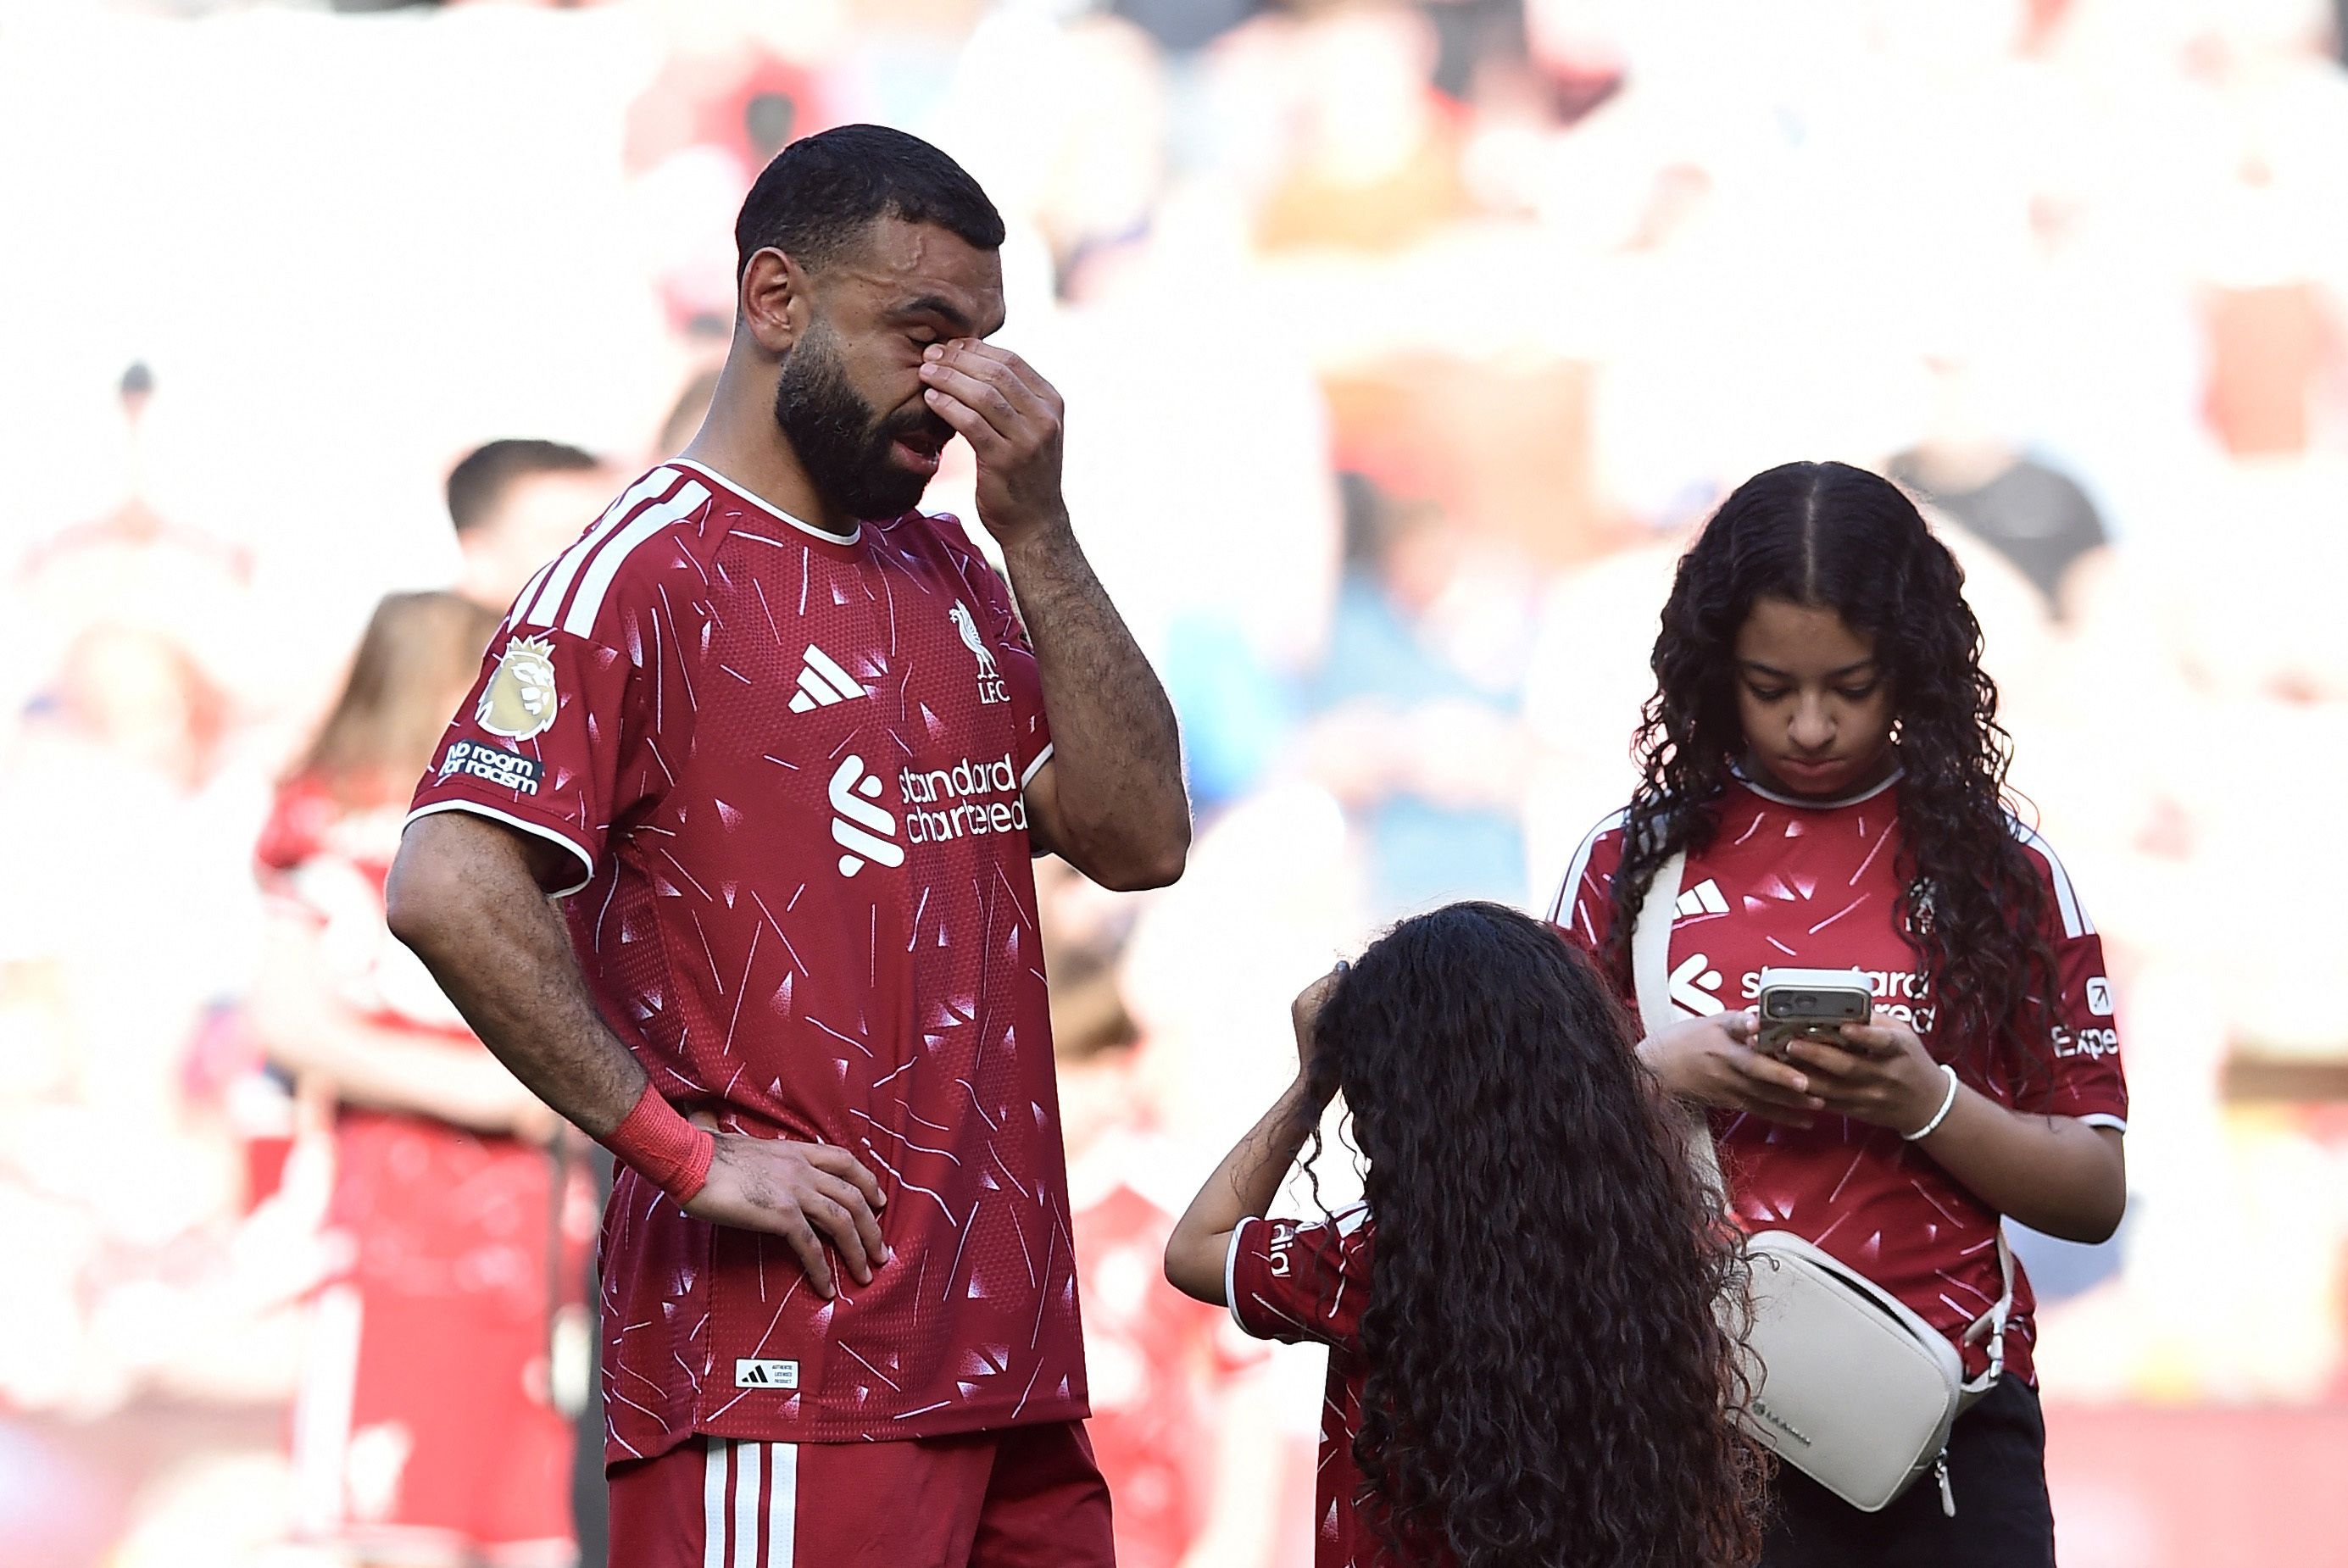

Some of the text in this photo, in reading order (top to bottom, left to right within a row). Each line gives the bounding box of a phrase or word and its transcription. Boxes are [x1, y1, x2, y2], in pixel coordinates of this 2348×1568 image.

[465, 761, 538, 795] racism
[471, 745, 534, 777] room
[899, 753, 1016, 803] standard
[907, 792, 1028, 842] chartered
